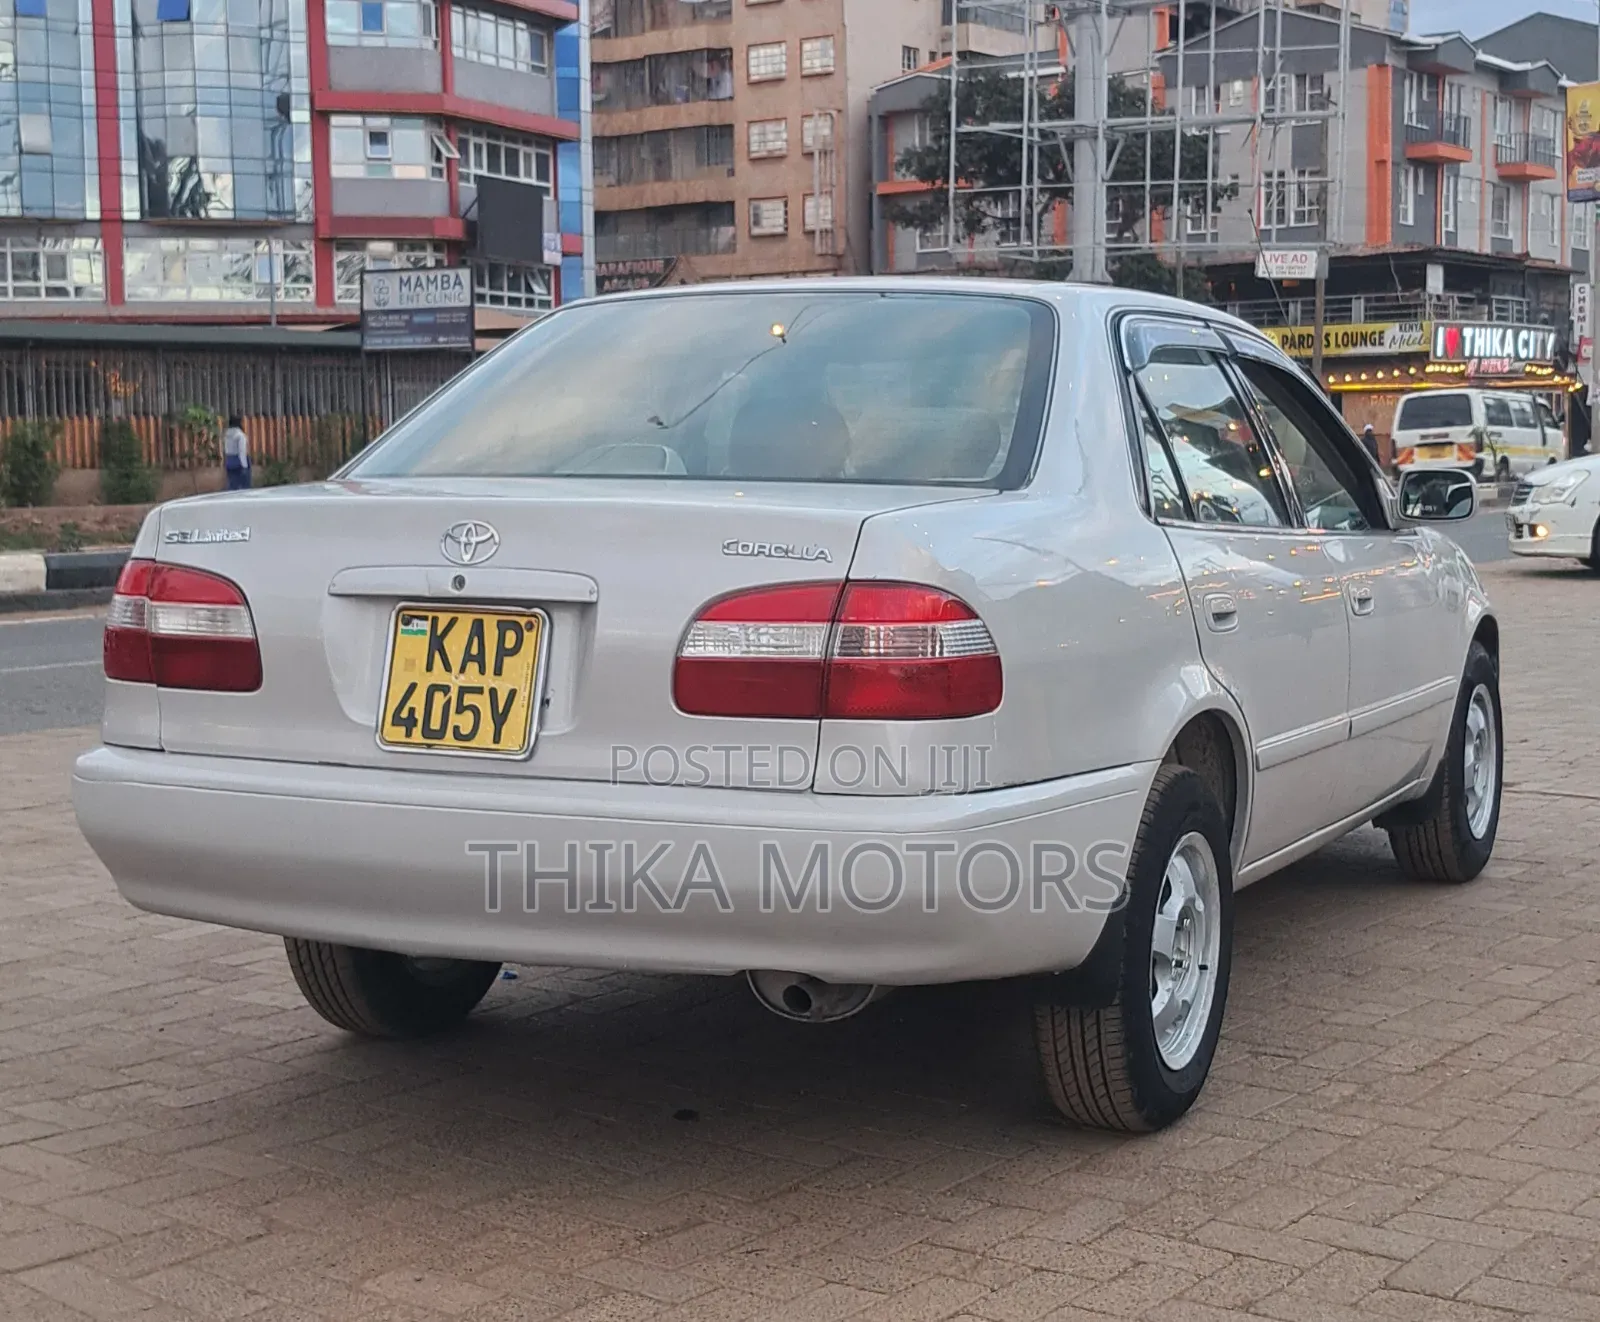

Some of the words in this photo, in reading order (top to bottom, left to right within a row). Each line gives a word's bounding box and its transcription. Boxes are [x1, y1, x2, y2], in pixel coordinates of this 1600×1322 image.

[1291, 253, 1309, 264] AD
[400, 273, 464, 292] MAMBA
[400, 294, 421, 305] ENT
[425, 292, 466, 304] CLINIC
[1577, 286, 1586, 337] CHEMI
[1399, 322, 1424, 332] KENYA
[1281, 332, 1331, 350] PARDS
[1335, 331, 1385, 348] LOUNGE
[1436, 326, 1445, 357] I
[1462, 327, 1515, 358] THIKA
[1517, 330, 1556, 360] CITY
[722, 538, 833, 563] COROLLA
[426, 615, 524, 677] KAP
[391, 682, 518, 744] 405Y
